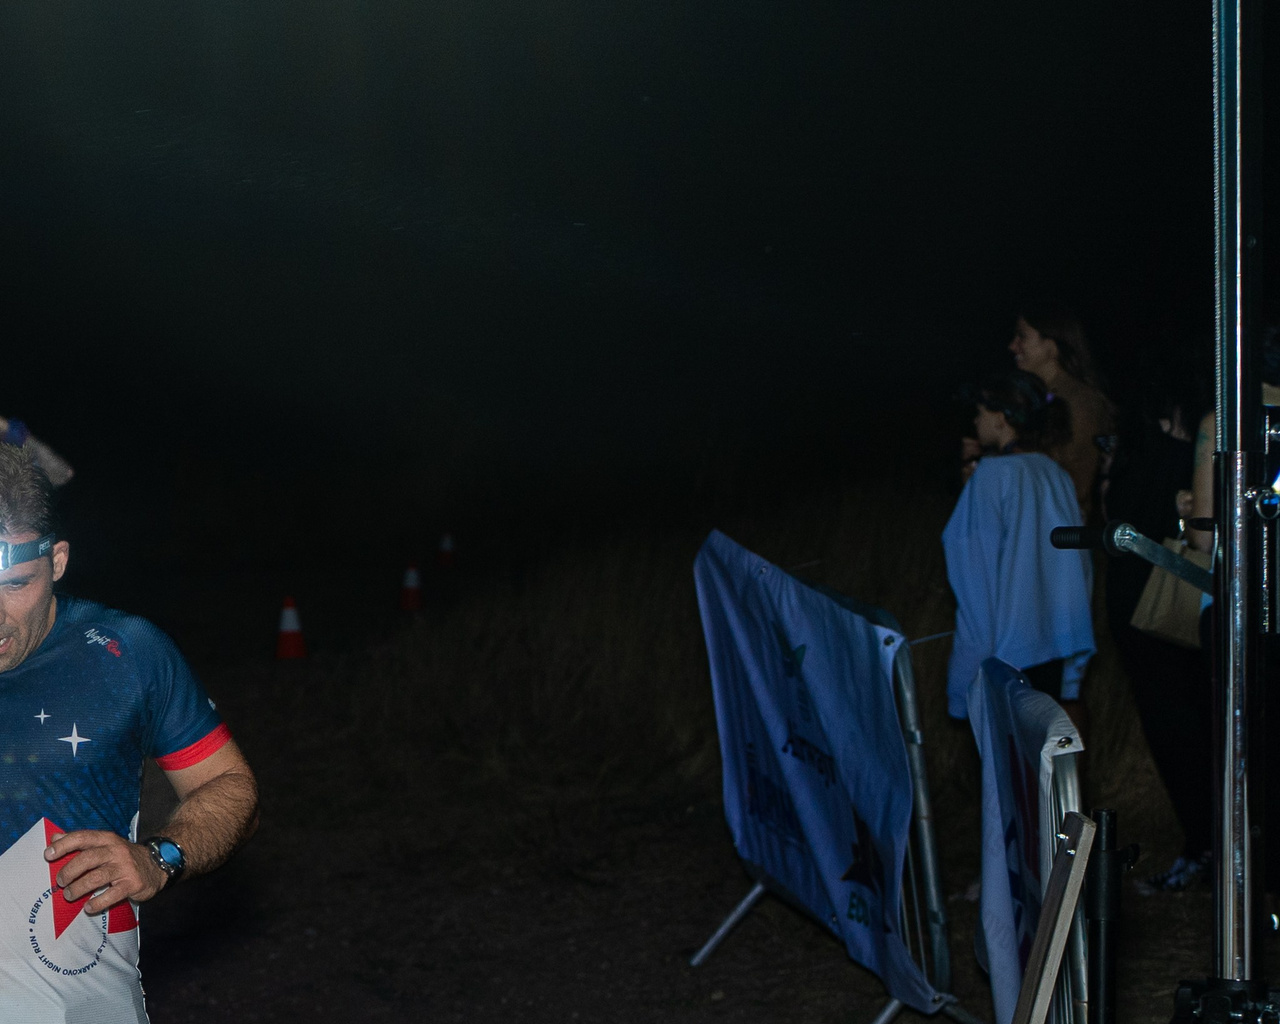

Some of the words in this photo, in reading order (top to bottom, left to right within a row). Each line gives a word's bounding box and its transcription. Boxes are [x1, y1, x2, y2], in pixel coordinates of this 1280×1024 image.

[84, 628, 111, 645] Night
[29, 897, 44, 925] EVERY
[29, 935, 42, 954] RUN
[38, 954, 62, 973] NIGHT
[62, 960, 98, 976] MARKOVO
